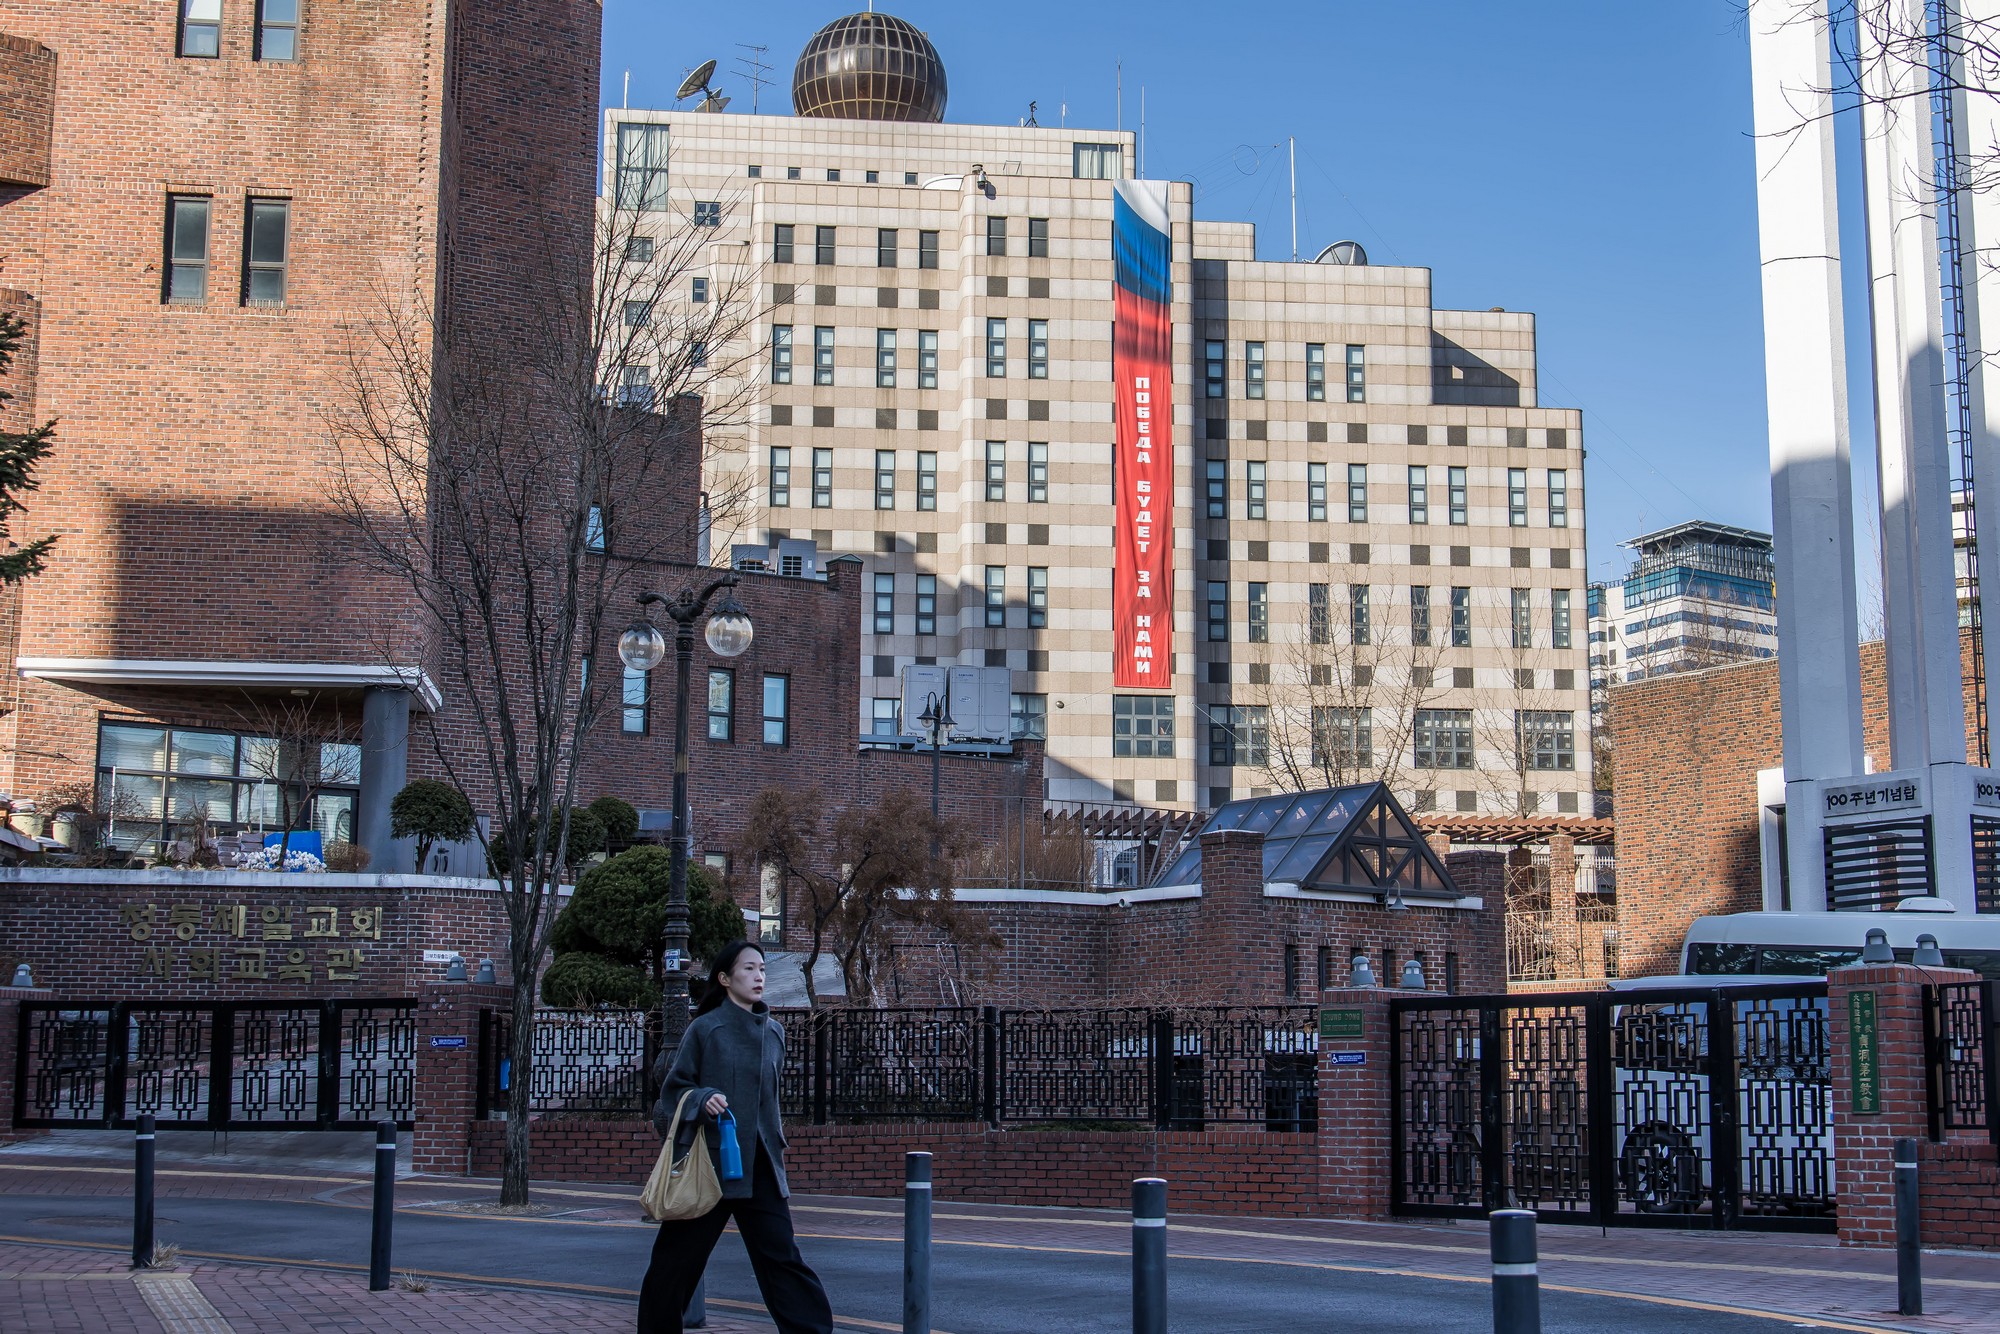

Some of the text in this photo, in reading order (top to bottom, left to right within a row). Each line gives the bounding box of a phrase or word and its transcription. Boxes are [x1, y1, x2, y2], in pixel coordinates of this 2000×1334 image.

[1134, 377, 1152, 673] ПОБЕДА БУДЕТ ЗА НАМИ
[1826, 785, 1917, 810] 100주년기념탑
[119, 904, 382, 940] 정동제일교회
[137, 948, 365, 983] 사회교육관
[669, 959, 674, 968] 2
